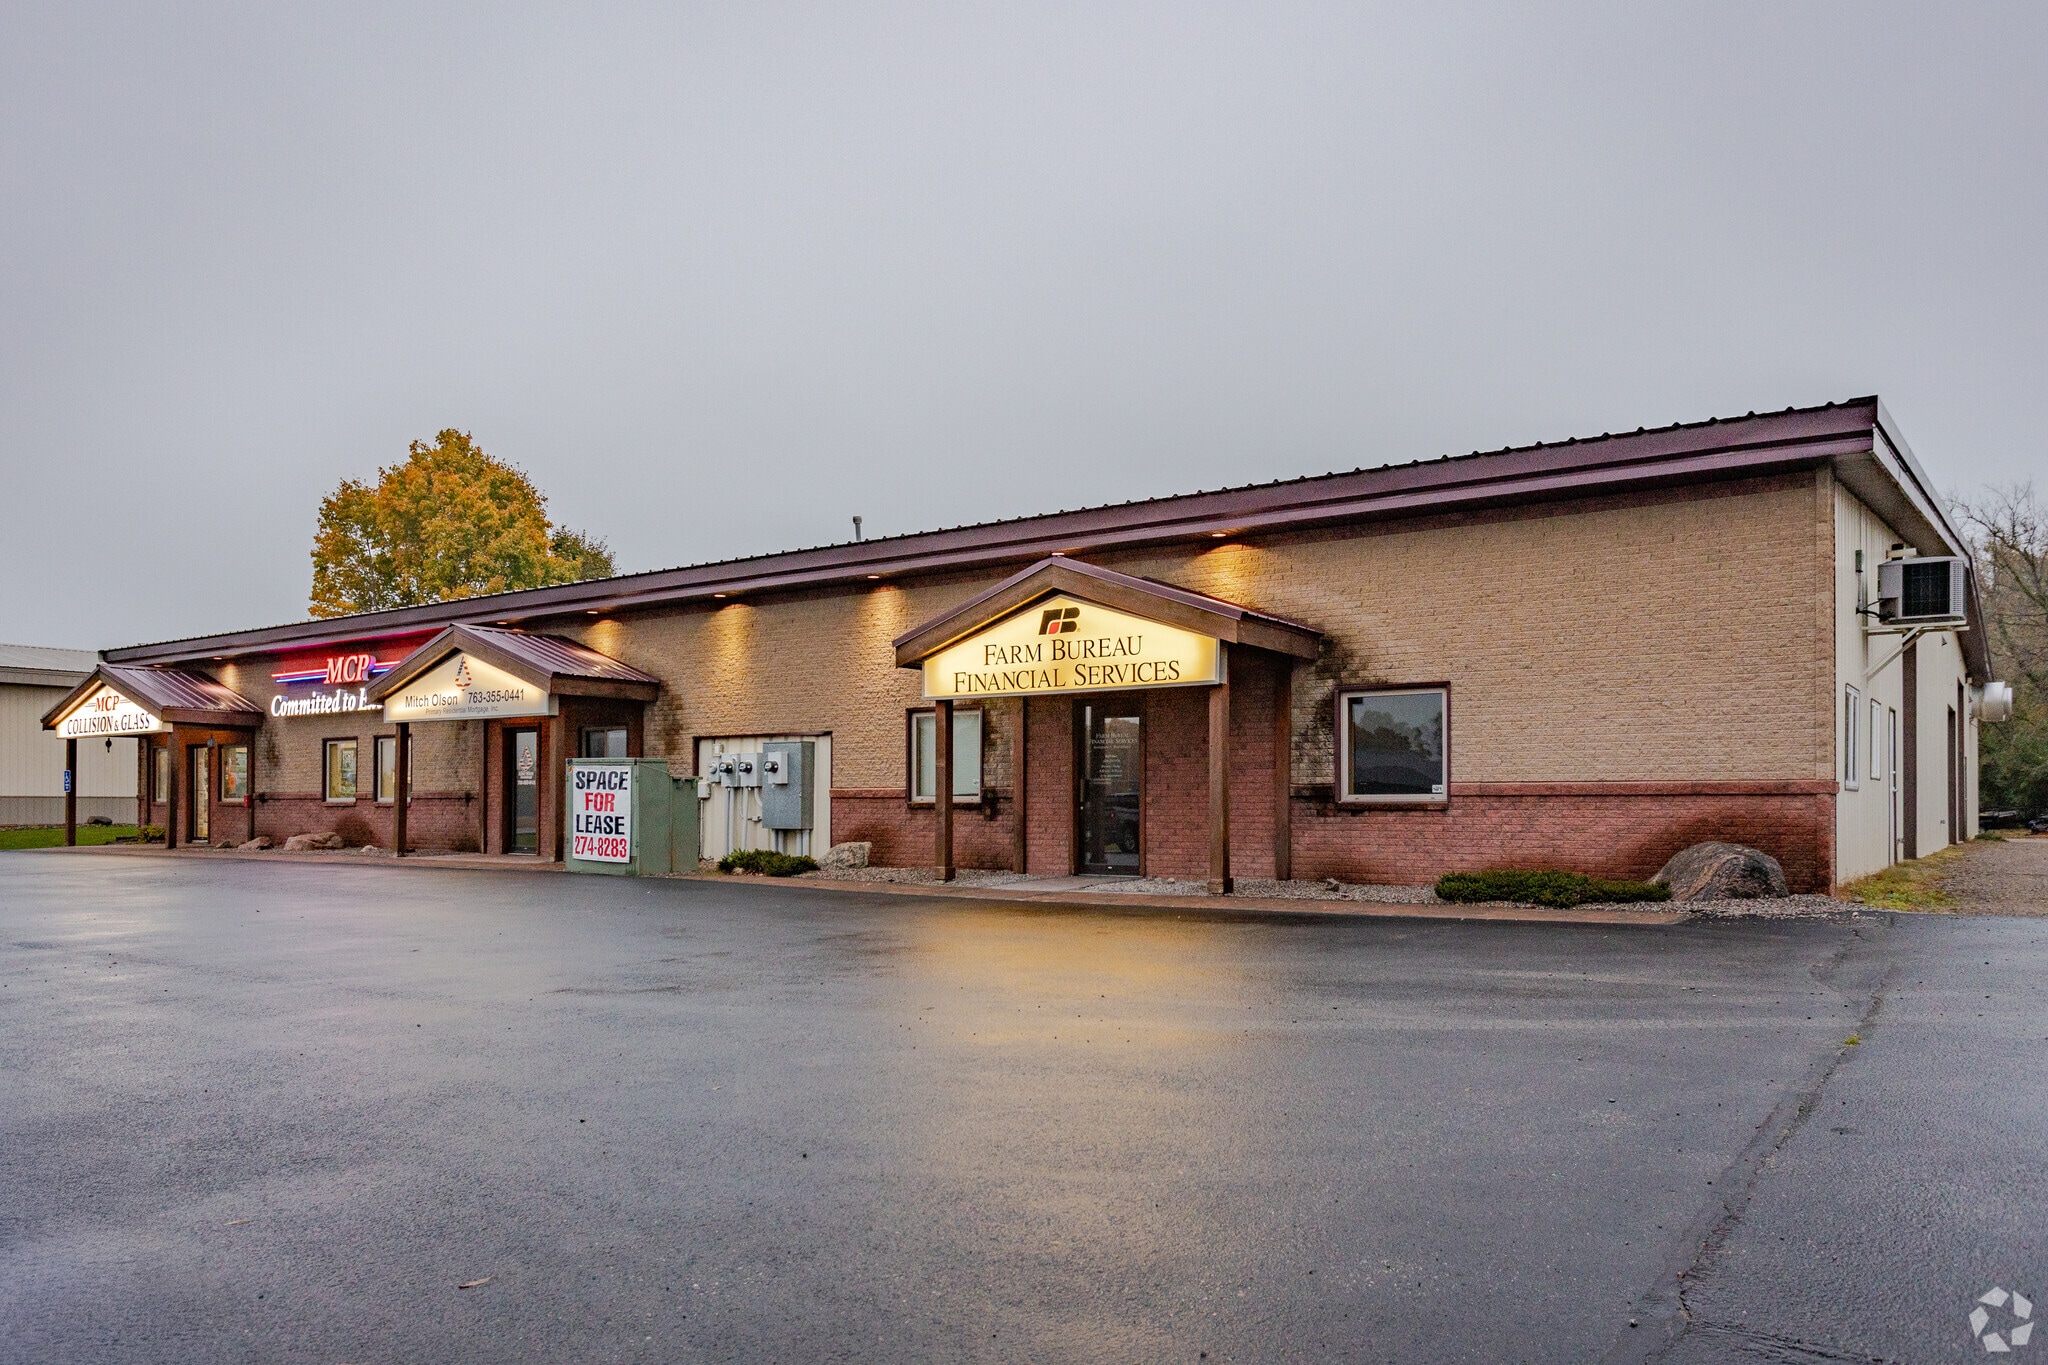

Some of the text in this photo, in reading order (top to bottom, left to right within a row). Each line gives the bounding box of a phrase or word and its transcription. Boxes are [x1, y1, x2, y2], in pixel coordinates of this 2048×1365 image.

[984, 635, 1143, 666] FARM BUREAU
[323, 654, 373, 684] MCP
[954, 660, 1180, 693] FINANCIAL SERVICES
[95, 695, 120, 712] MCP
[271, 688, 342, 717] Committed
[343, 692, 356, 712] to
[405, 693, 458, 708] Mitch Olson
[468, 688, 525, 704] 763-355-0441
[67, 712, 150, 735] COLLISION & GLASS
[575, 771, 628, 790] SPACE
[585, 792, 615, 812] FOR
[576, 814, 625, 835] LEASE
[575, 836, 627, 858] 274-8283
